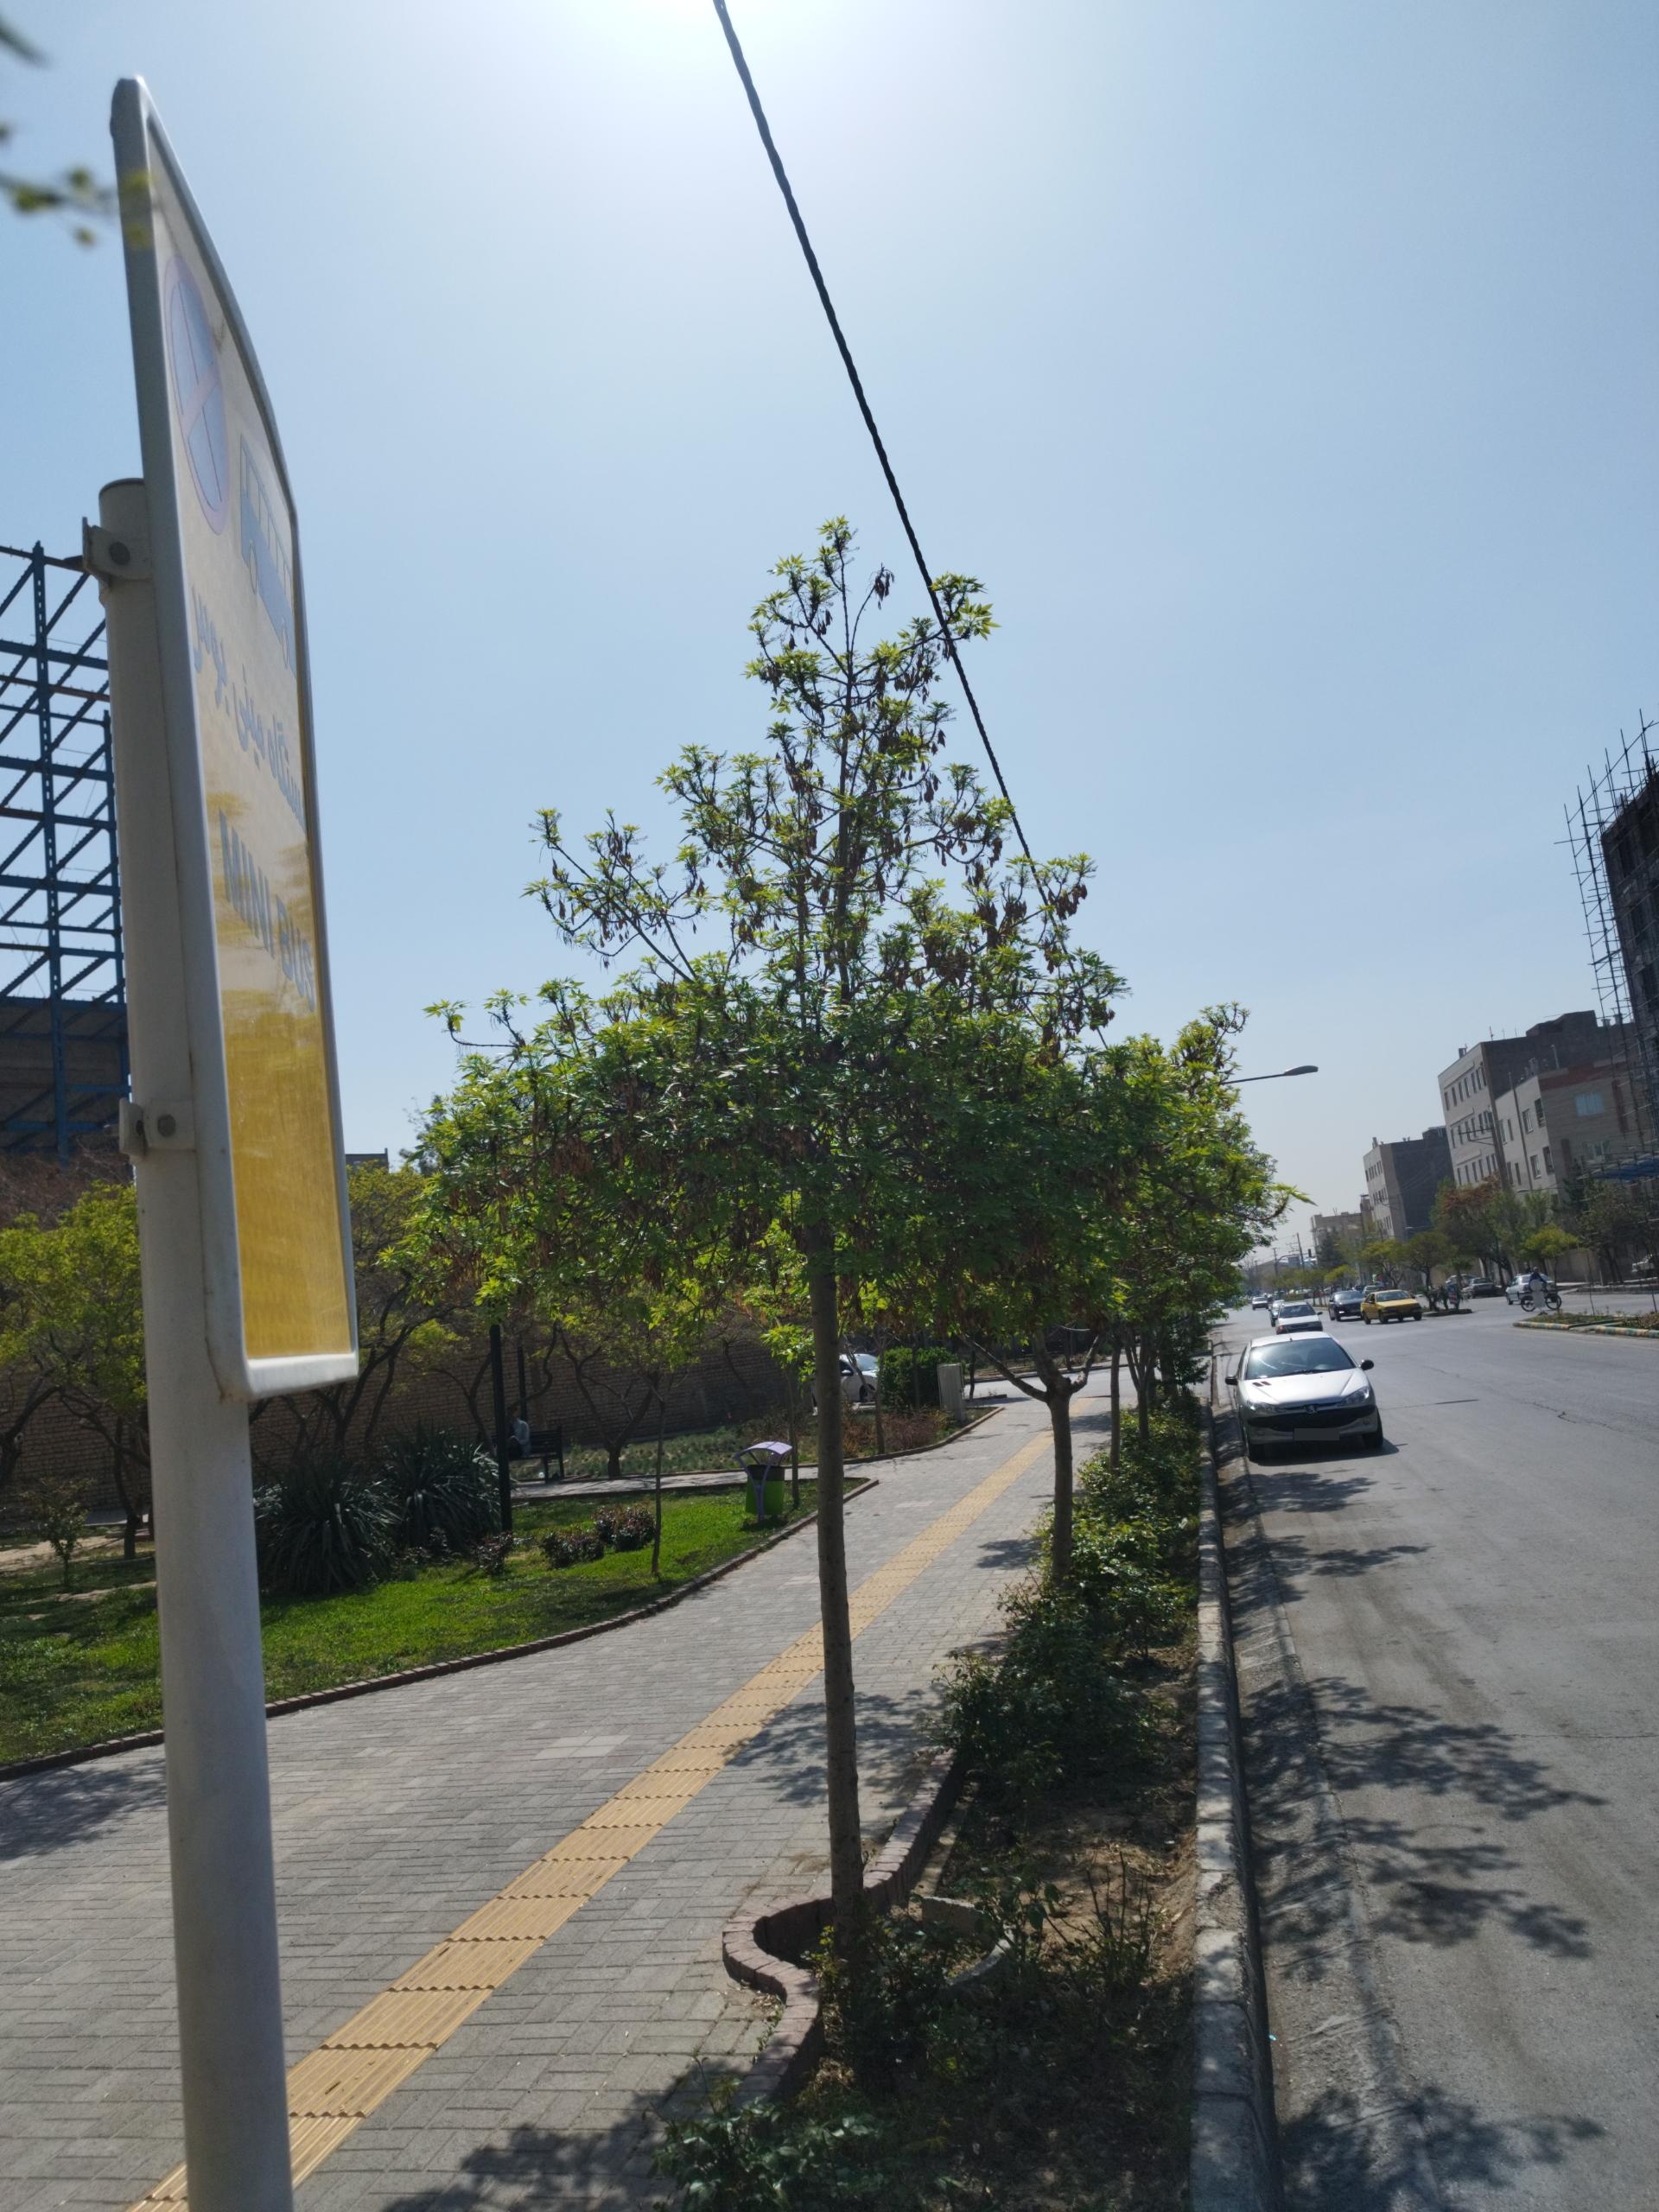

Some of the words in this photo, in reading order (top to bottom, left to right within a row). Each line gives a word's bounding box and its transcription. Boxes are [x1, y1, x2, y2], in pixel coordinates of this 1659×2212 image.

[193, 589, 230, 715] بوس
[233, 664, 265, 769] مینی
[219, 809, 276, 960] MINI
[276, 895, 315, 1011] BUS
